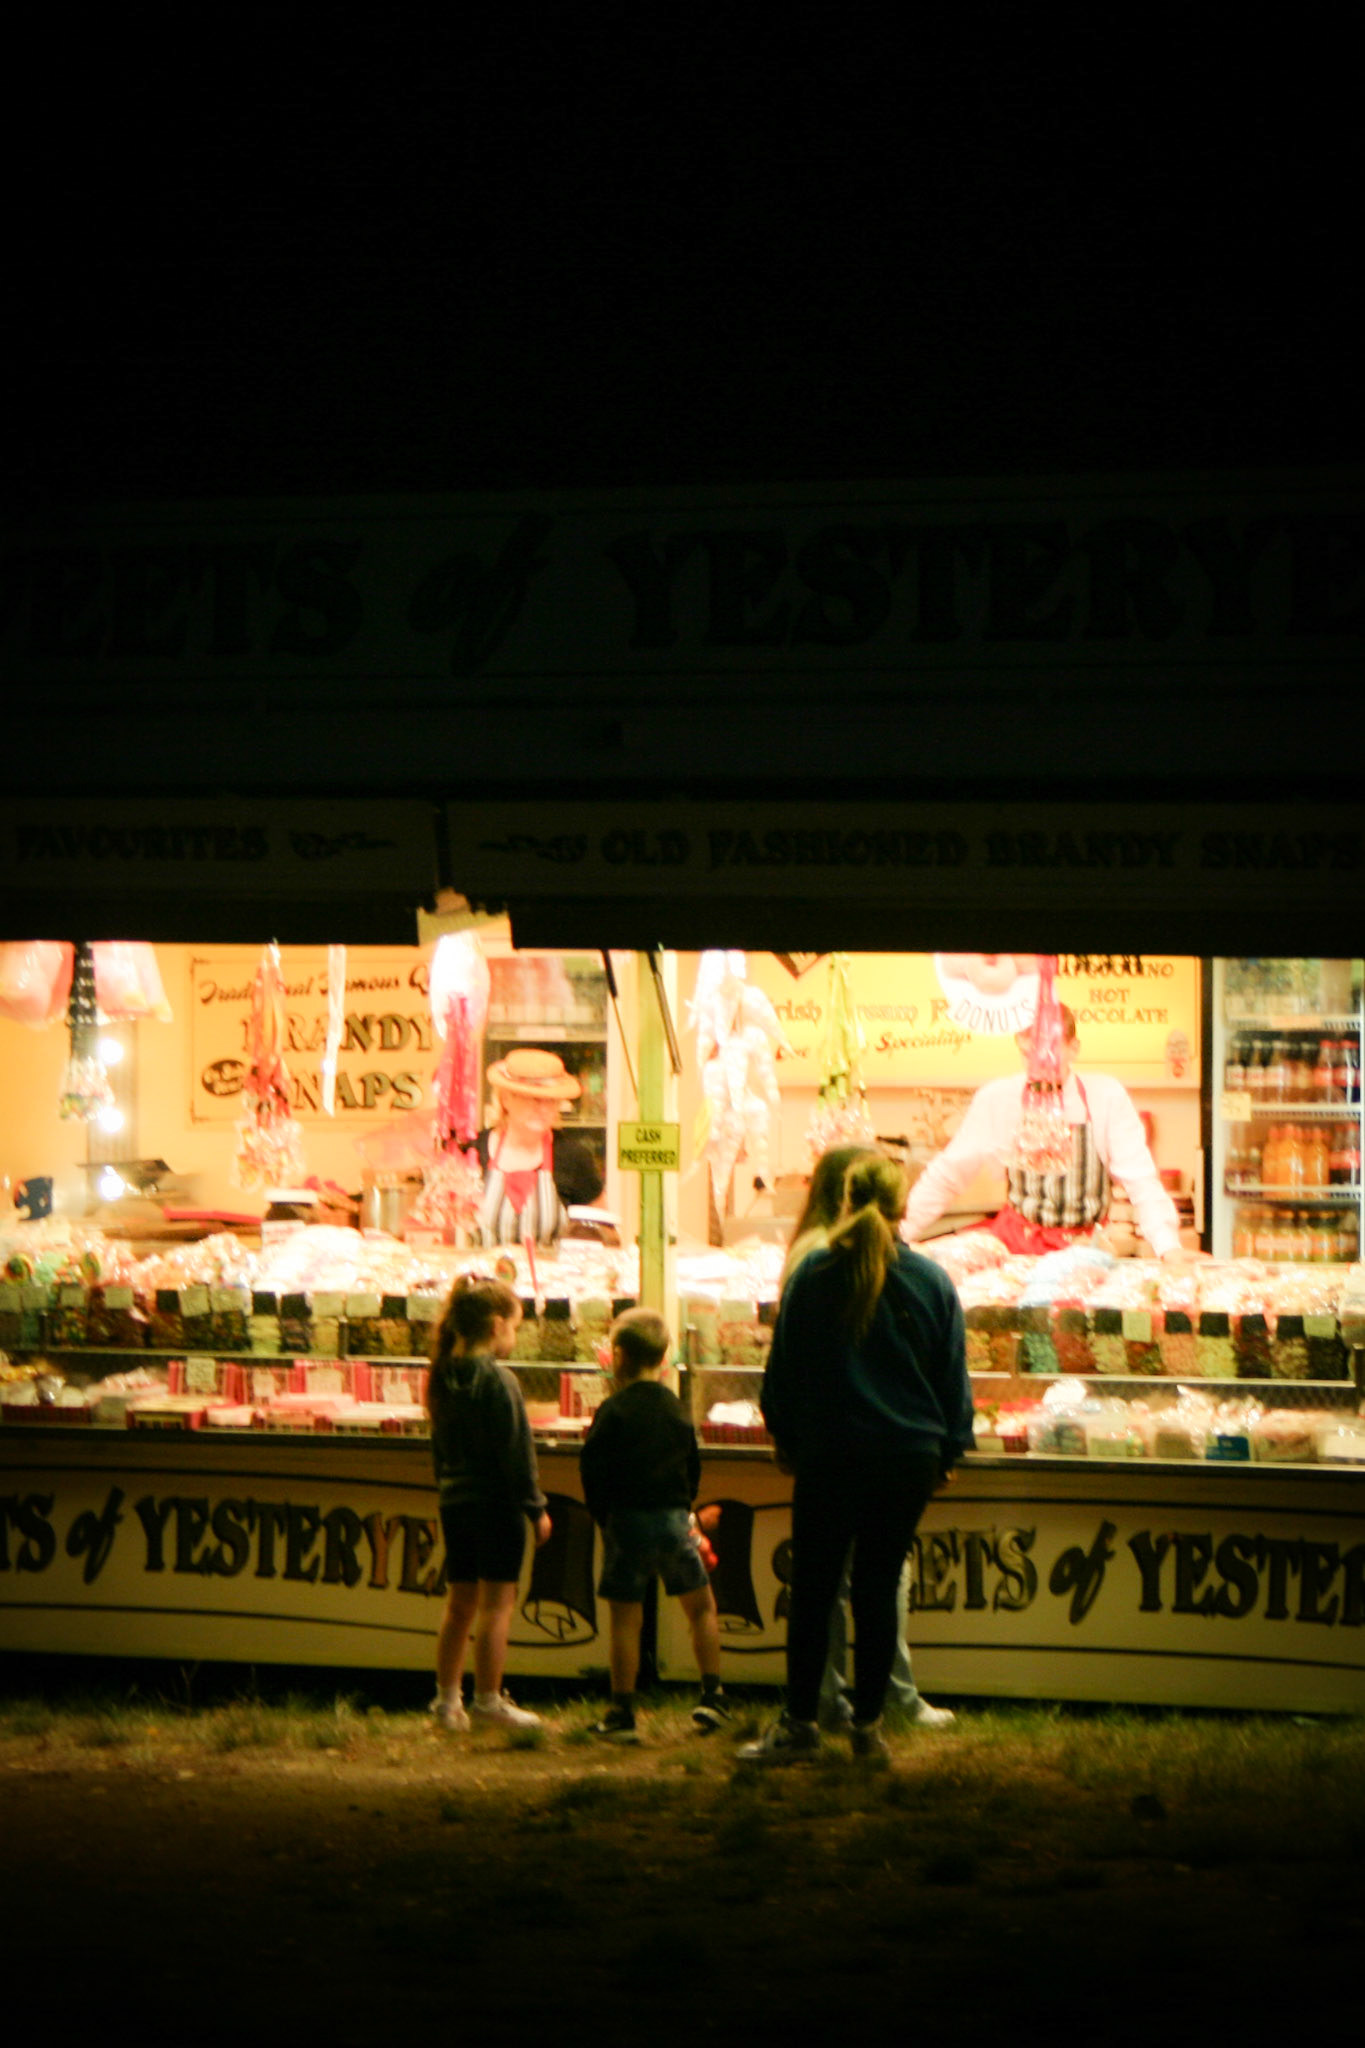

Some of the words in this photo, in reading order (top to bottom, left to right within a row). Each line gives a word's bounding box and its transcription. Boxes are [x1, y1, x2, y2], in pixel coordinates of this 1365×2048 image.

[408, 508, 554, 678] of
[600, 828, 692, 867] OLD
[707, 828, 969, 869] FASHIONED
[986, 828, 1183, 868] BRANDY
[1200, 830, 1361, 869] SNAPS
[1089, 986, 1130, 1004] HOT
[954, 998, 1035, 1032] DONUTS
[635, 1127, 662, 1144] CASH
[621, 1149, 676, 1165] PREFERRED
[66, 1486, 124, 1584] of
[135, 1496, 446, 1597] YESTERYE
[1049, 1519, 1116, 1624] of
